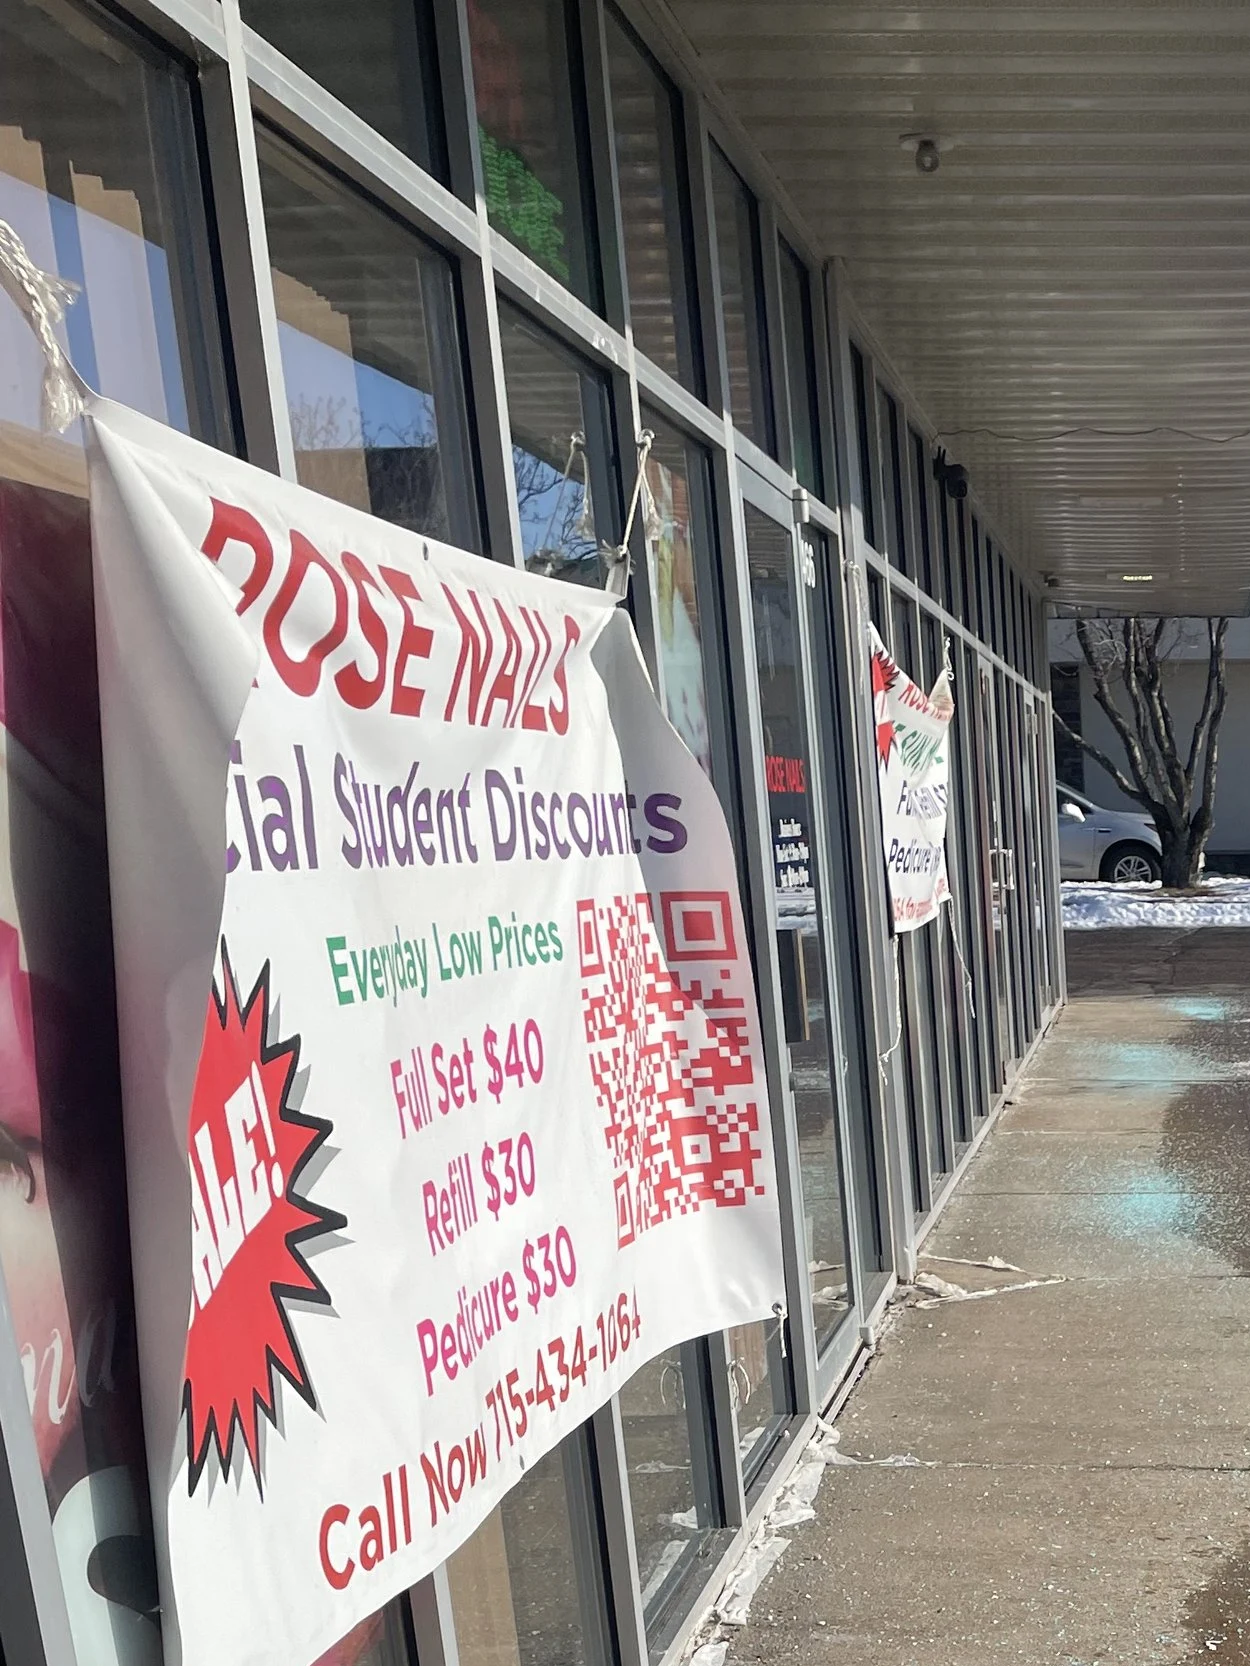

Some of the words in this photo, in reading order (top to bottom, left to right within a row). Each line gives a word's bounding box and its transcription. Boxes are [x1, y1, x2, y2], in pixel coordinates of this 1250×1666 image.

[439, 582, 581, 736] NAILS
[226, 740, 318, 874] ial
[333, 751, 480, 870] Student
[484, 766, 688, 863] Discounts
[326, 925, 427, 1007] Everyday
[432, 922, 482, 982] Low
[487, 911, 564, 973] Prices
[390, 1046, 433, 1140] Full
[431, 1037, 477, 1115] Set
[483, 1018, 544, 1104] $40
[188, 1060, 284, 1326] ALE!
[422, 1152, 478, 1257] Refill
[481, 1132, 536, 1222] $30
[416, 1271, 519, 1397] Pedicure
[522, 1226, 577, 1315] $30
[318, 1464, 412, 1591] Call
[420, 1422, 487, 1528] Now
[485, 1285, 641, 1463] 715-434-1064
